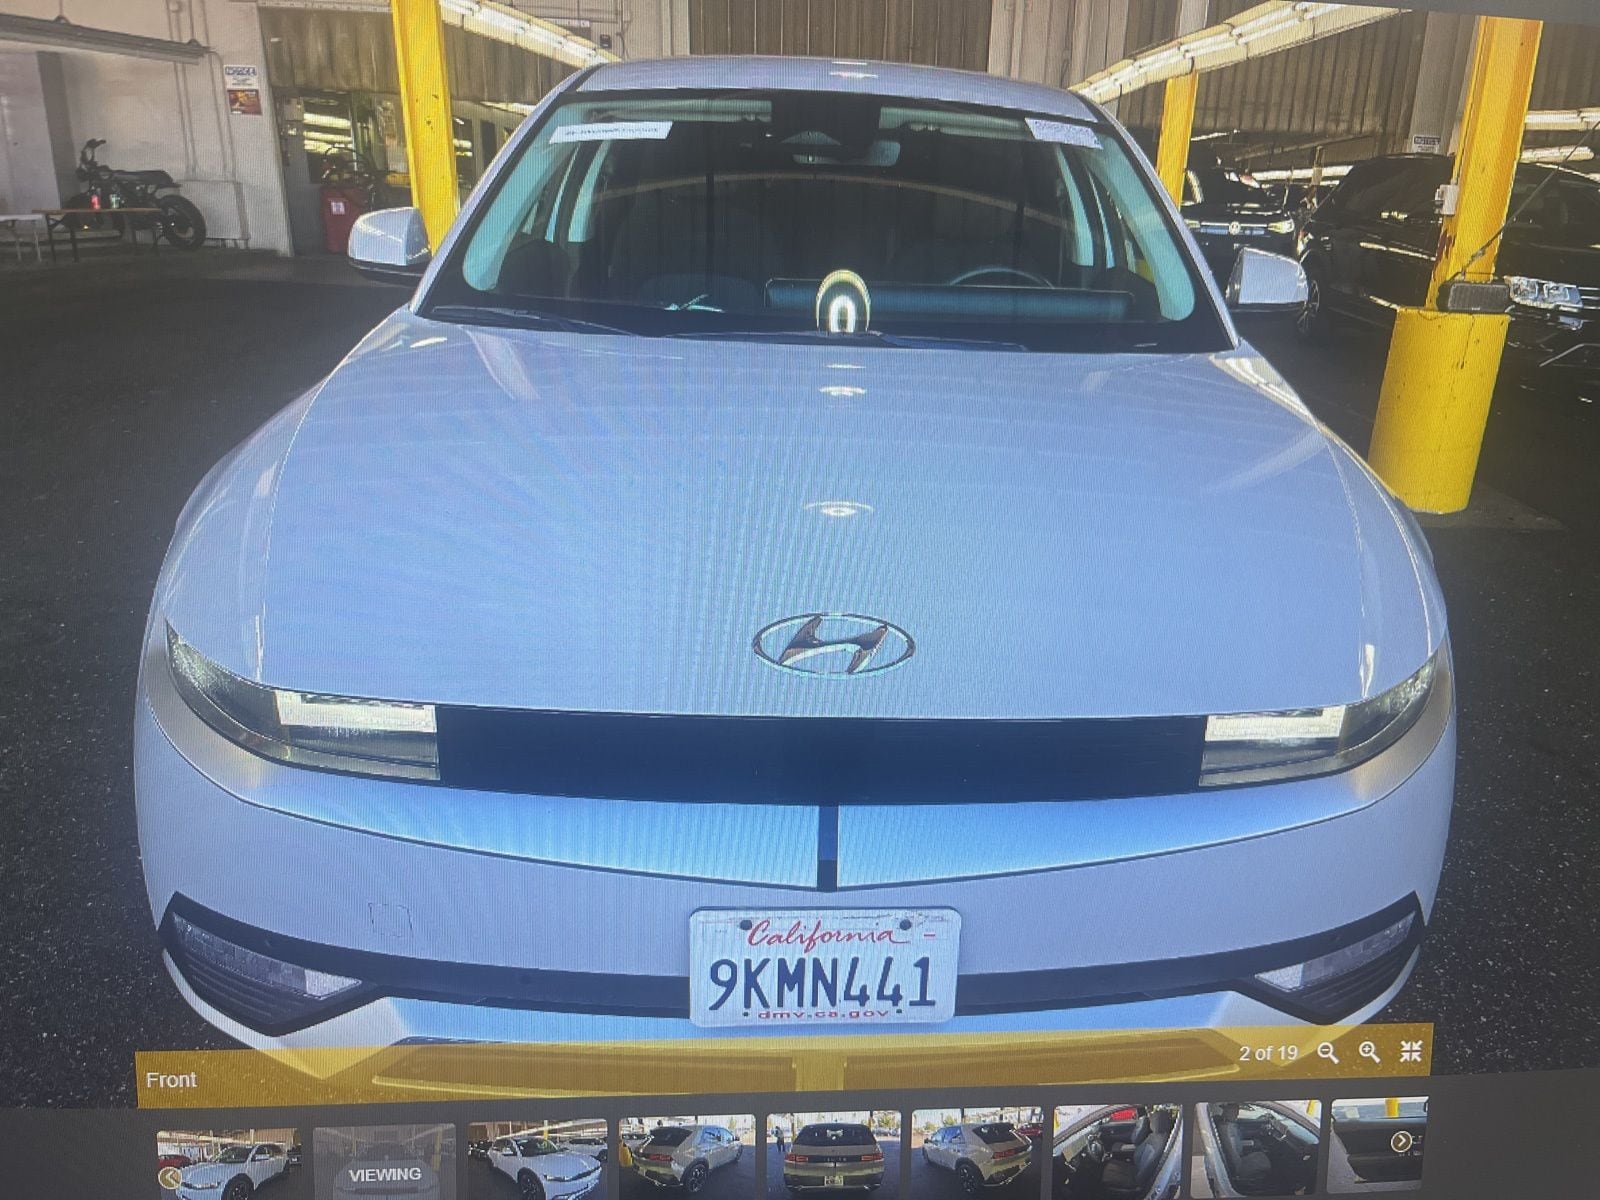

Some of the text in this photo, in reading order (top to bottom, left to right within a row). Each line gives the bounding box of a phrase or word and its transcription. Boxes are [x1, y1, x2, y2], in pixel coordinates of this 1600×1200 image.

[748, 919, 911, 953] California
[709, 956, 937, 1011] 9KMN441
[757, 1009, 889, 1020] dmv.ca.gov
[1239, 1045, 1299, 1061] 2 of 19
[146, 1072, 198, 1088] Front
[349, 1168, 422, 1183] VIEWING
